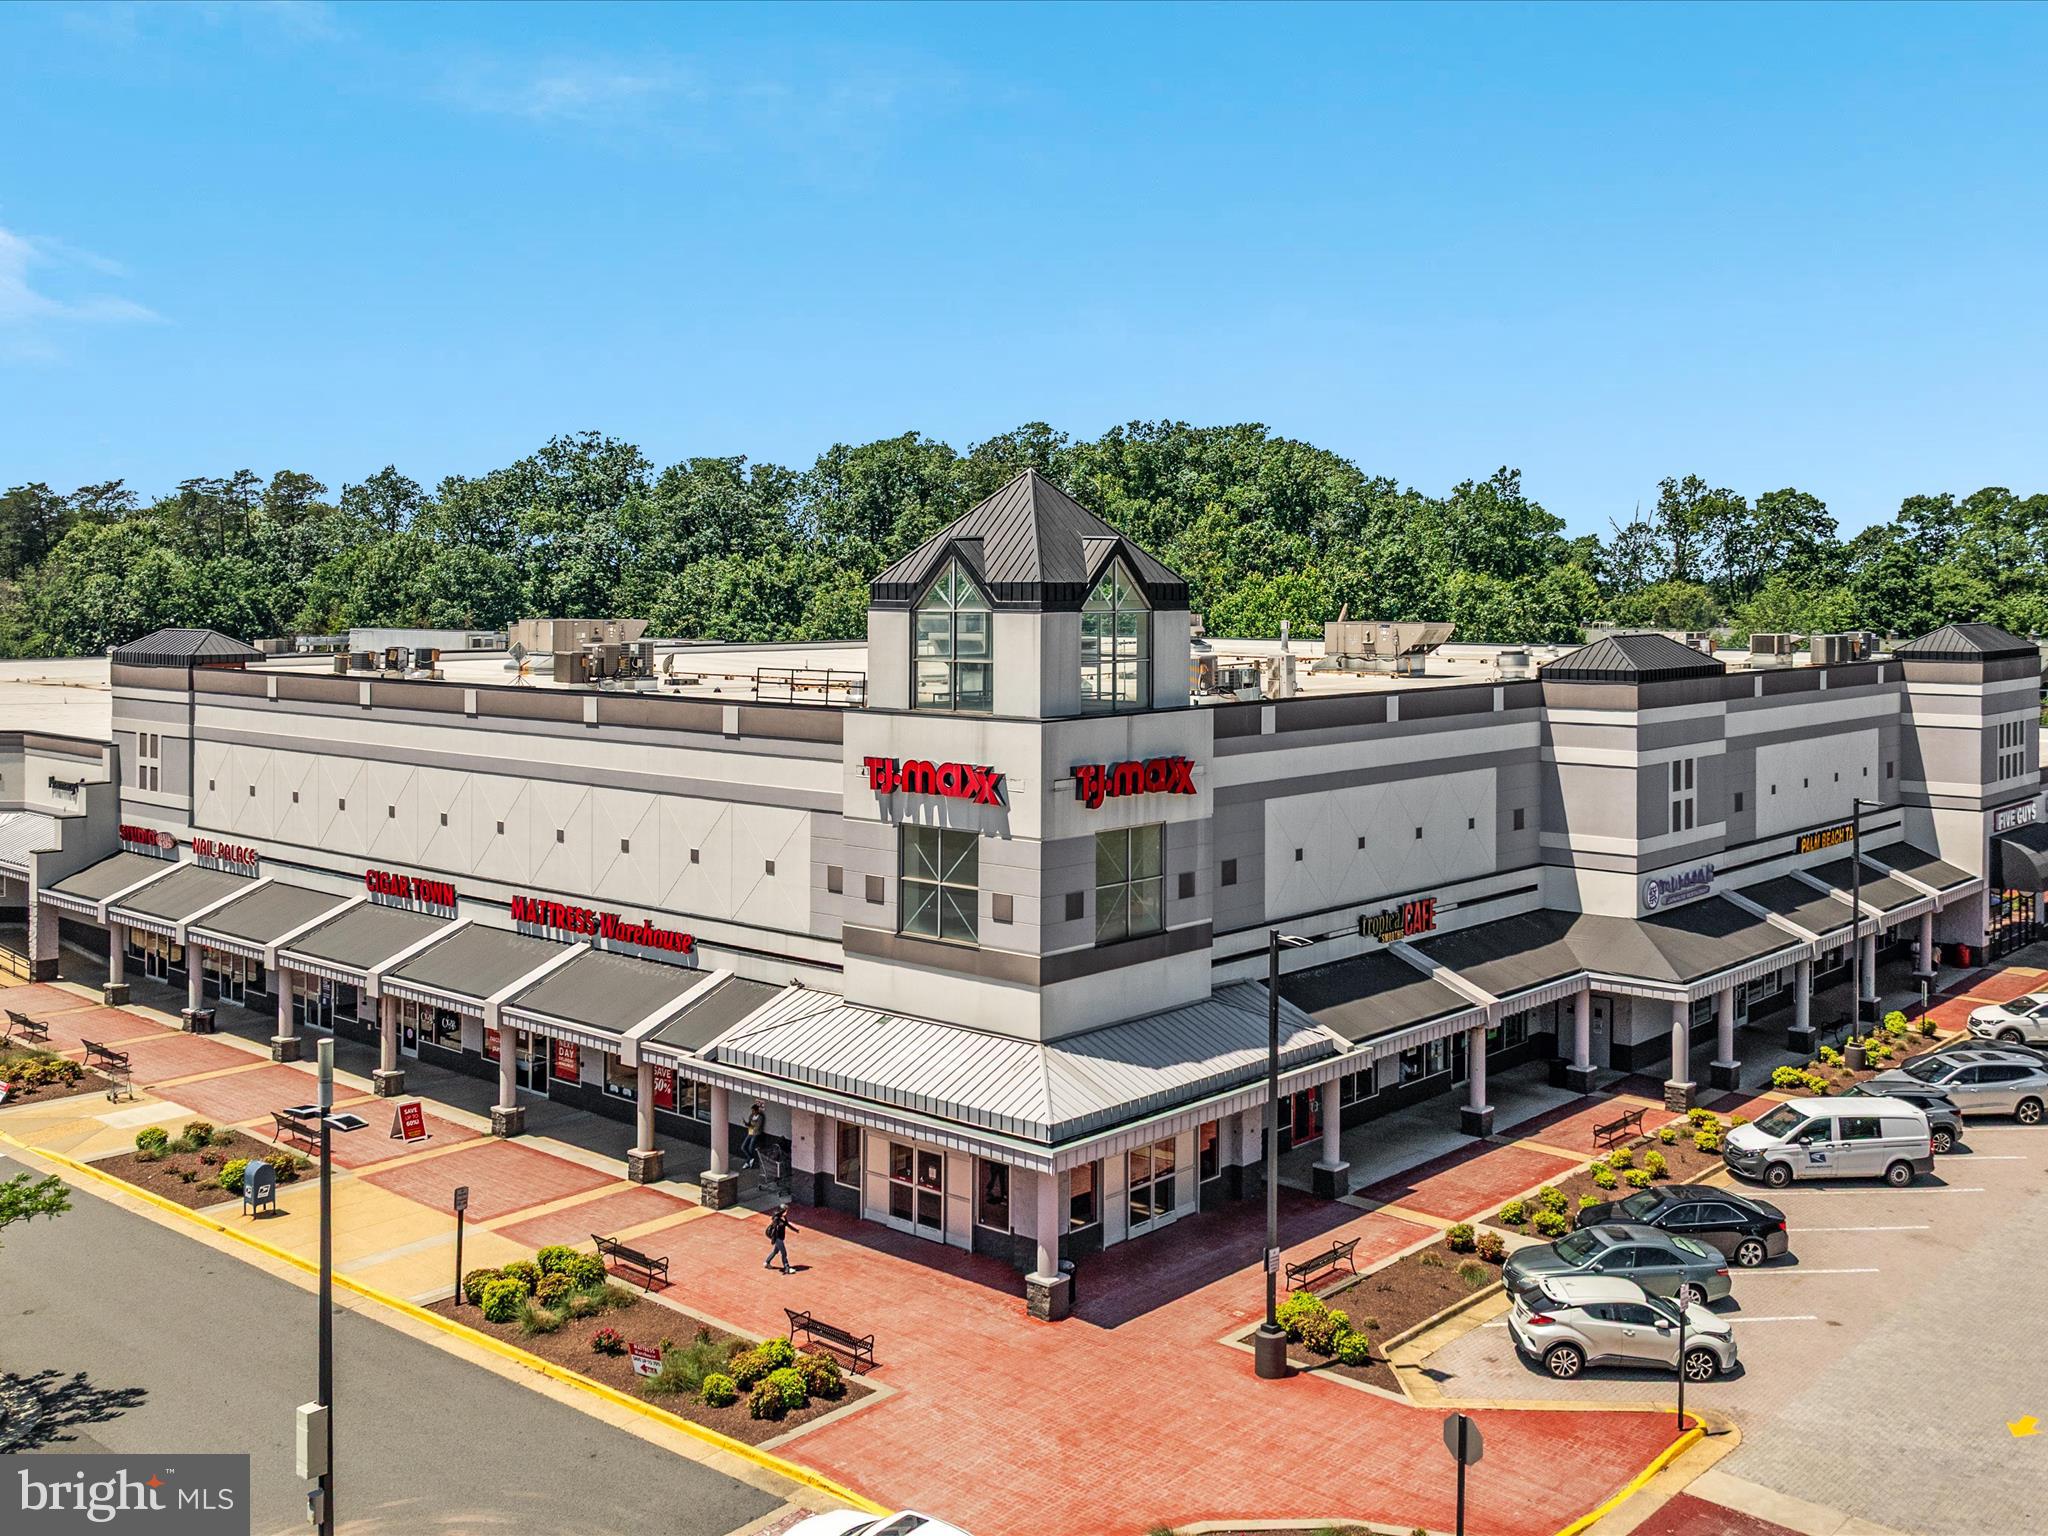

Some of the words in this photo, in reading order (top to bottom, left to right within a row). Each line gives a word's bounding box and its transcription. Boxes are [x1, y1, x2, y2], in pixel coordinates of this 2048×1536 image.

[2016, 803, 2036, 825] GUYS
[119, 825, 157, 846] STUDIO
[1799, 832, 1821, 854] PALM
[1821, 826, 1844, 848] BEACH
[192, 837, 216, 858] NAIL
[218, 842, 256, 866] PALACE
[366, 869, 411, 899] CIGAR
[411, 877, 457, 908] TOWN
[511, 895, 597, 936] MATTRESS
[600, 912, 697, 955] Warehouse
[1404, 897, 1437, 936] CAFE
[558, 1047, 574, 1059] DAY
[654, 1065, 672, 1079] SAVE
[654, 1078, 671, 1094] 50%
[403, 1107, 418, 1115] SAVE
